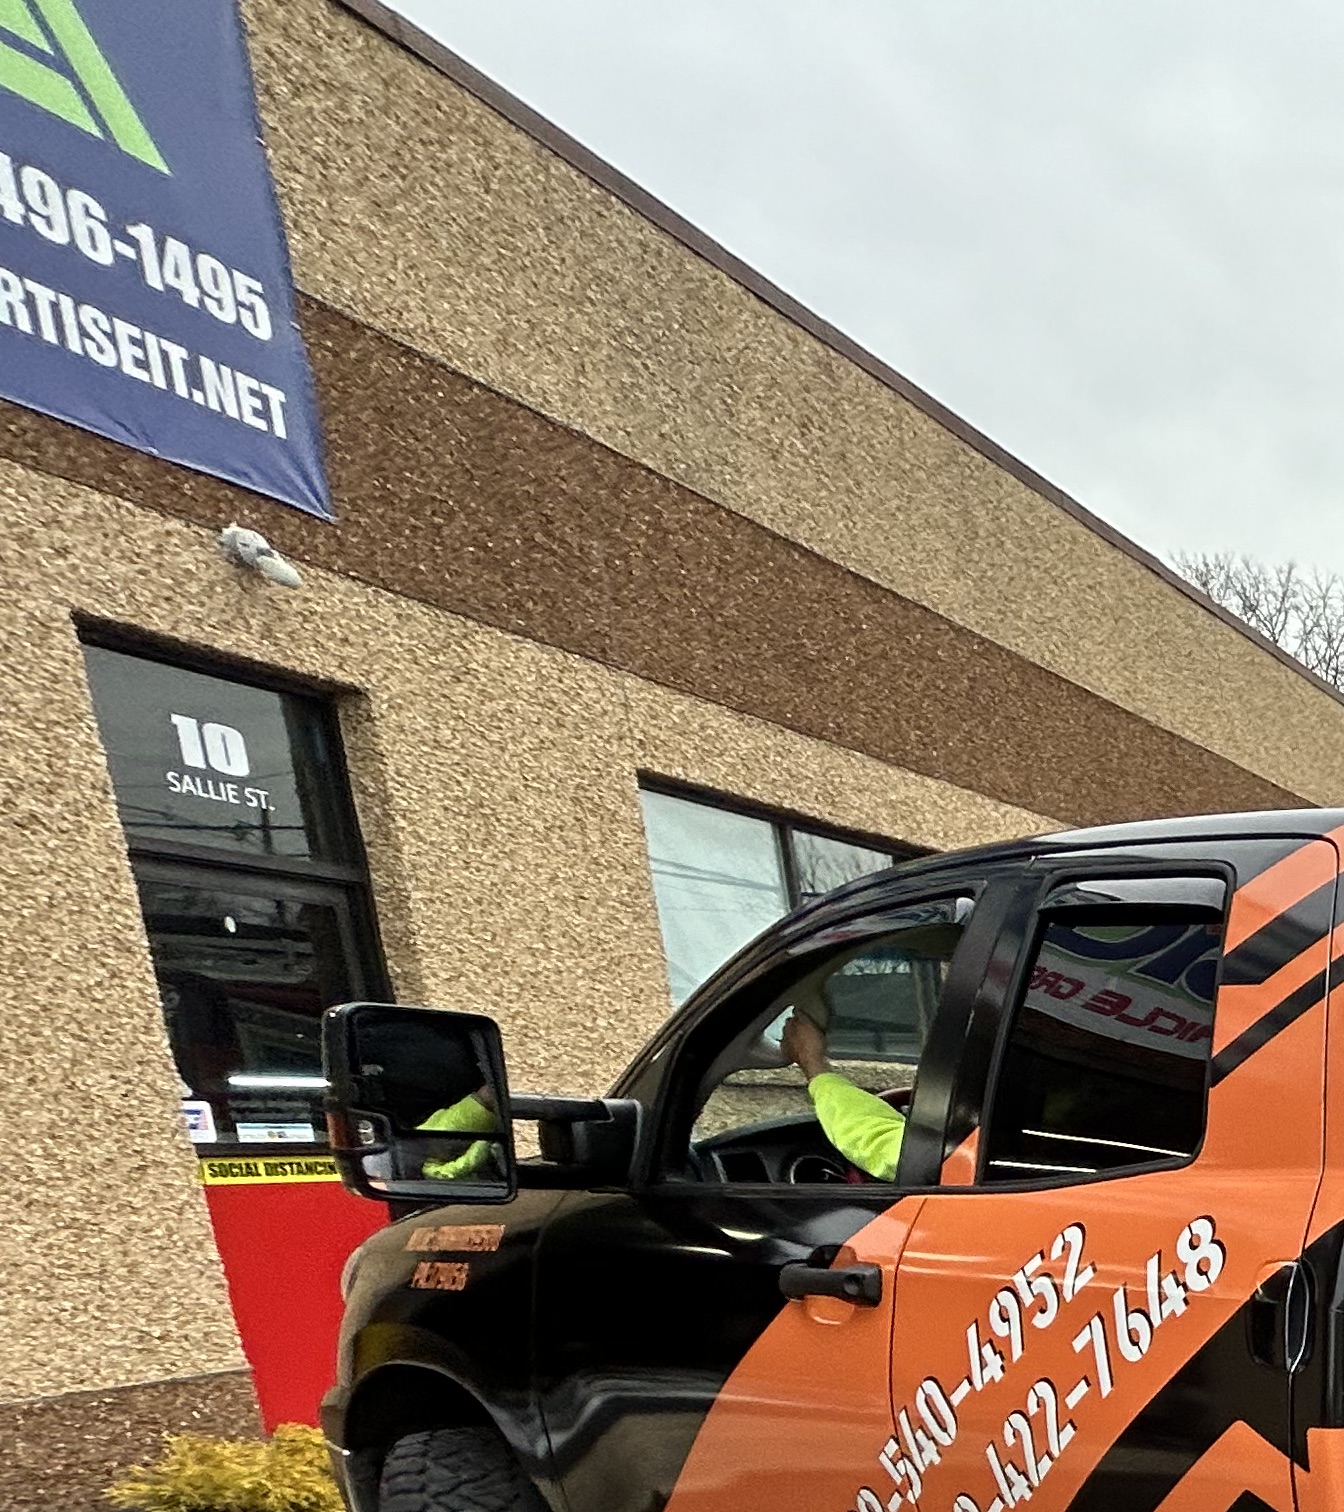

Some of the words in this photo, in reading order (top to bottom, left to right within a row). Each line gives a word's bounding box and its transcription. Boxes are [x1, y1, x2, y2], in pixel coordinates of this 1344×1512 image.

[170, 713, 250, 777] 10
[166, 771, 241, 805] SALLIE
[244, 787, 276, 811] ST.
[208, 1161, 262, 1179] SOCIAL
[264, 1160, 337, 1177] DISTANCIN
